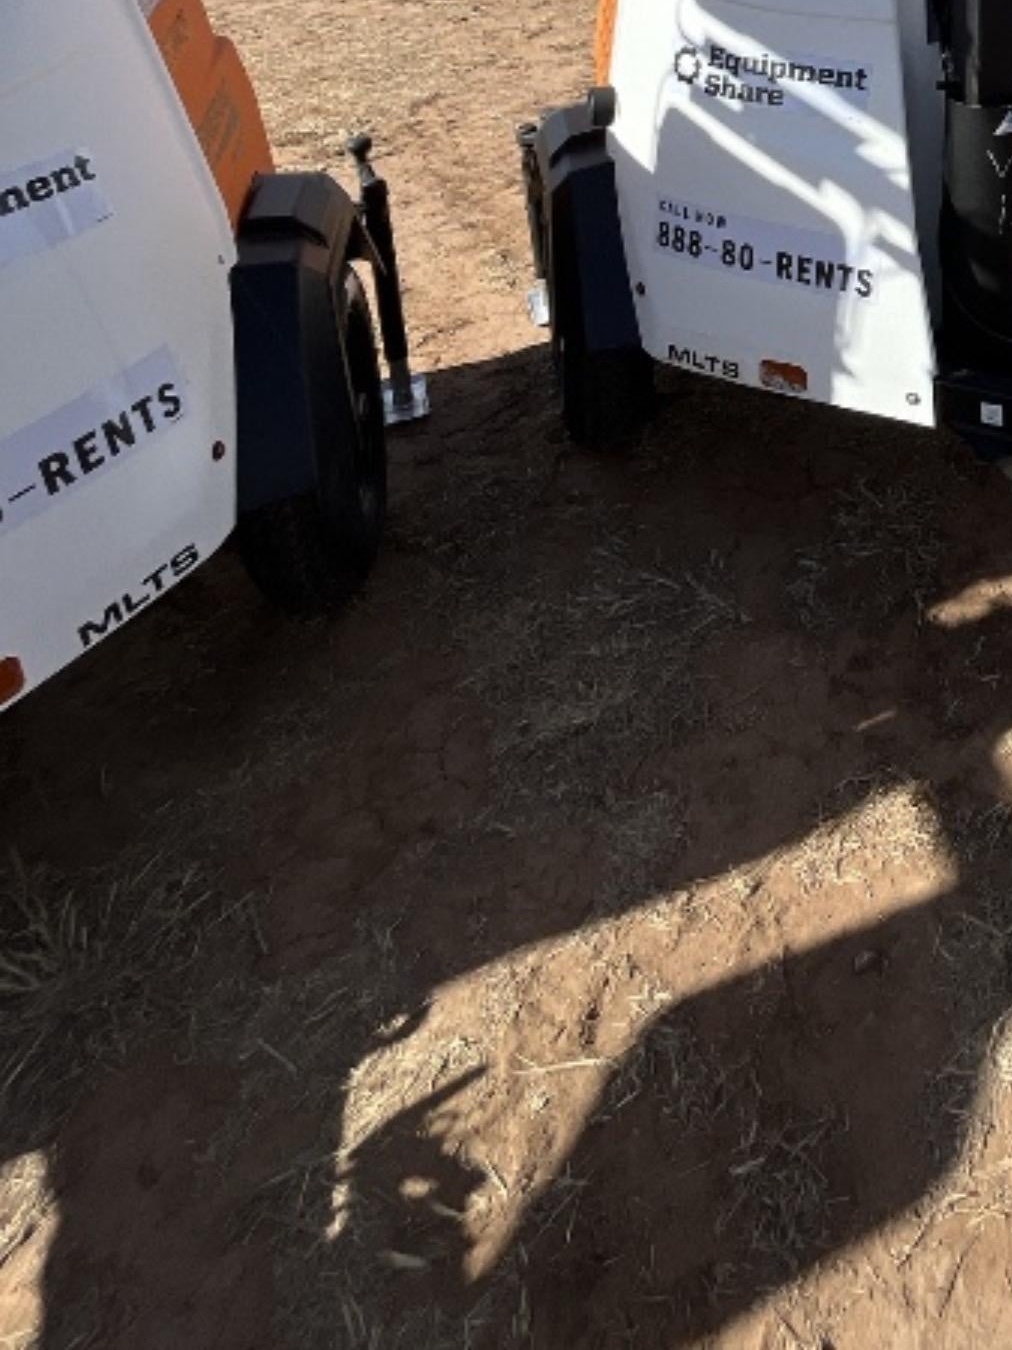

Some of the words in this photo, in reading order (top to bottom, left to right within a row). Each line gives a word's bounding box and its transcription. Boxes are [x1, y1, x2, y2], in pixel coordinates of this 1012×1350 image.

[703, 73, 785, 107] Share
[708, 44, 868, 90] Equipment
[656, 221, 874, 298] 888-80-RENTS
[0, 382, 182, 523] -RENTS
[76, 542, 200, 648] MLTS
